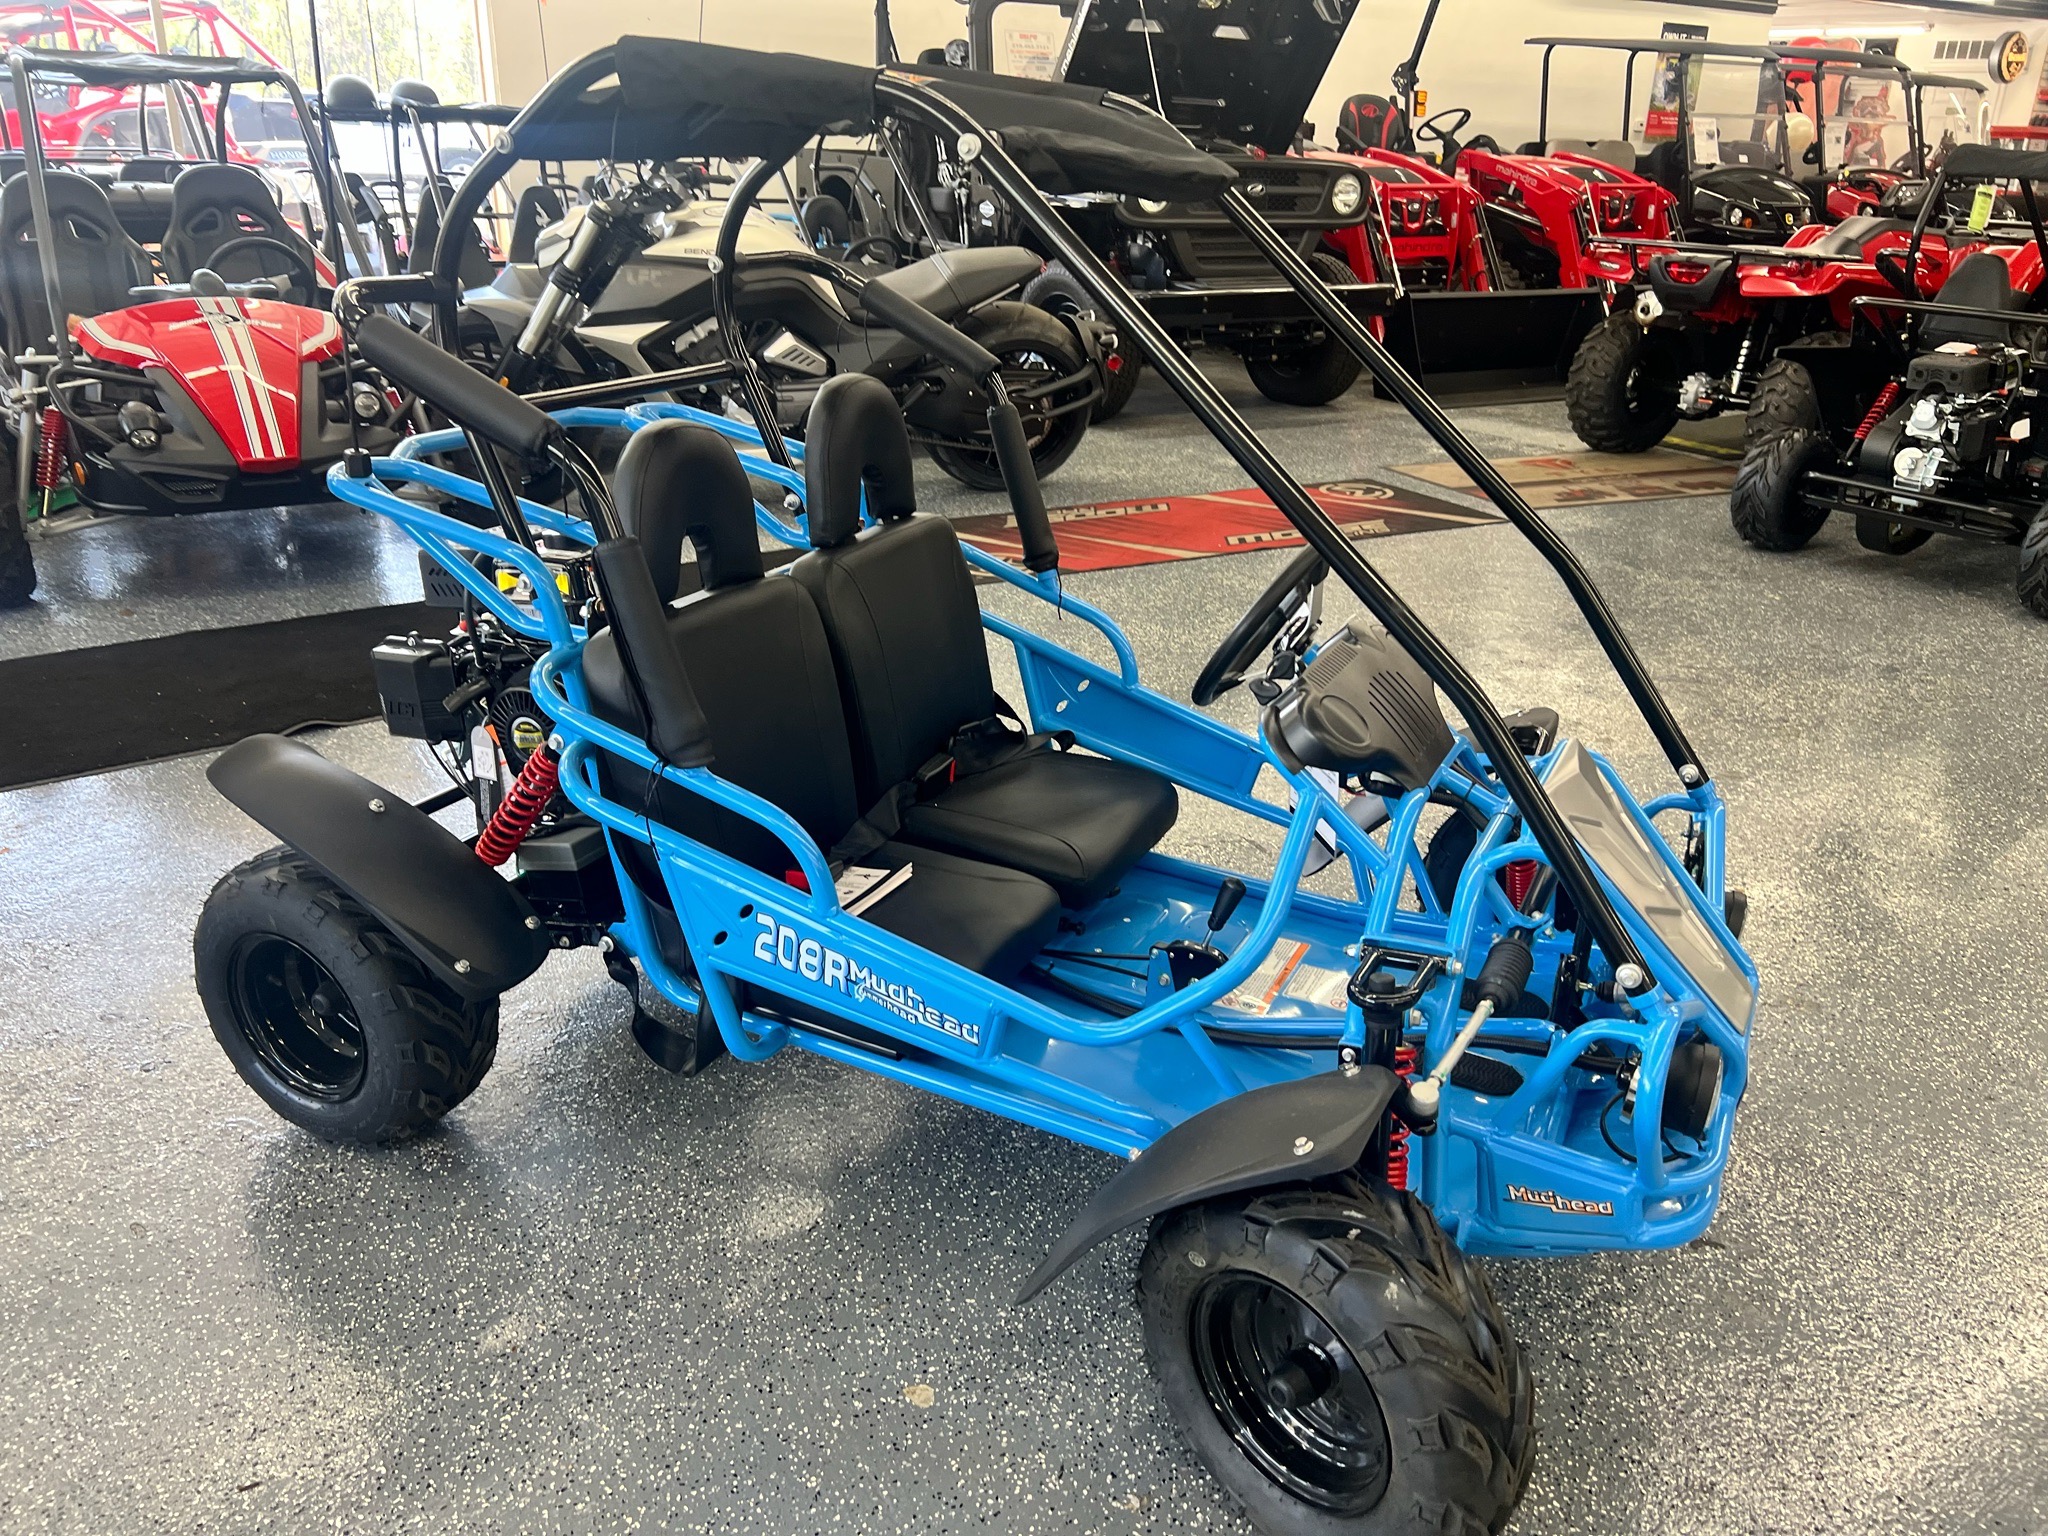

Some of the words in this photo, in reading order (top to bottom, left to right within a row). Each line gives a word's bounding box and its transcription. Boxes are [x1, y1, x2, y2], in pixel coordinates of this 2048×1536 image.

[1495, 163, 1538, 188] mahindra
[684, 247, 716, 256] BEND
[754, 911, 852, 998] 208R
[848, 958, 981, 1047] Mudhead
[1506, 1184, 1614, 1215] Mudhead
